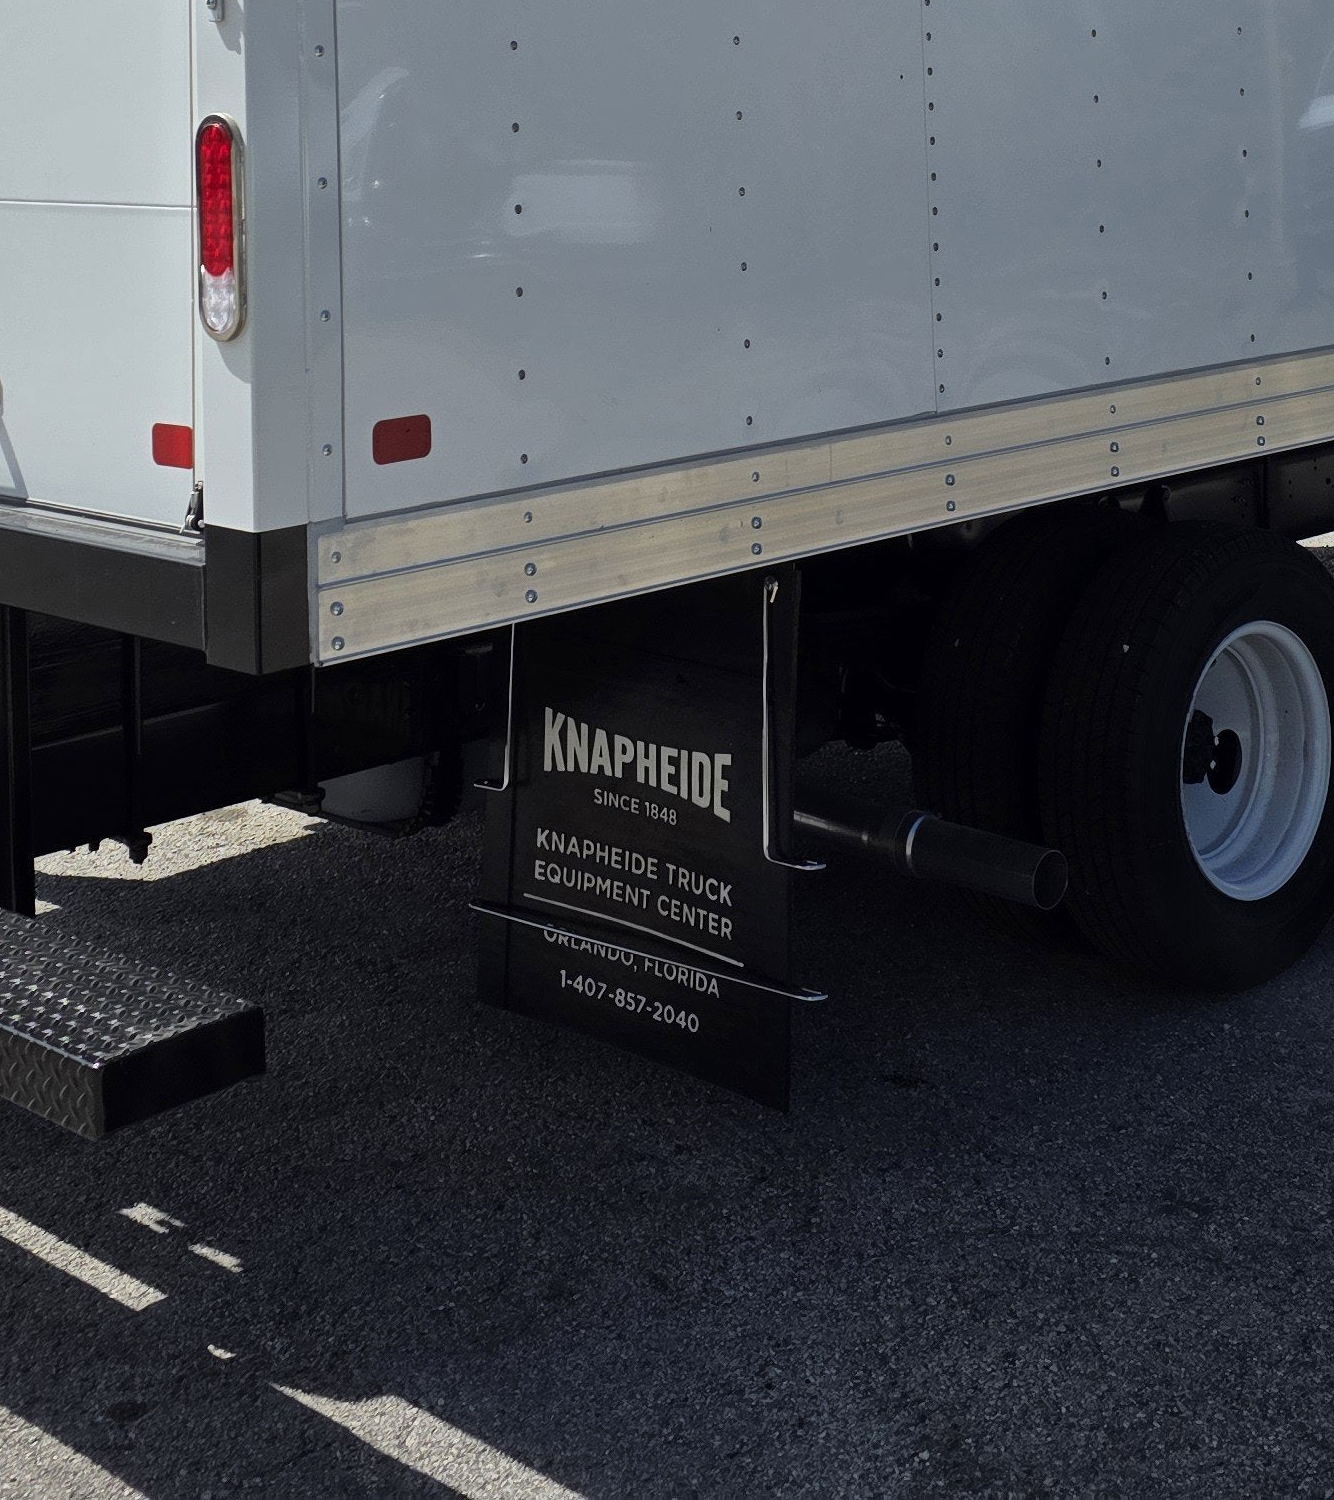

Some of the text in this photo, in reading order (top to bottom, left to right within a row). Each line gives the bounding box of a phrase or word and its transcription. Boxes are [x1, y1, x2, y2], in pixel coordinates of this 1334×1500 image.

[543, 706, 732, 824] KNAPHEIDE
[593, 788, 678, 826] SINCE 1848
[534, 859, 733, 941] EQUIPMENT CENTER
[536, 827, 733, 908] KNAPHEIDE TRUCK
[558, 969, 701, 1034] 1-407-857-2040
[645, 957, 721, 999] FLORIDA
